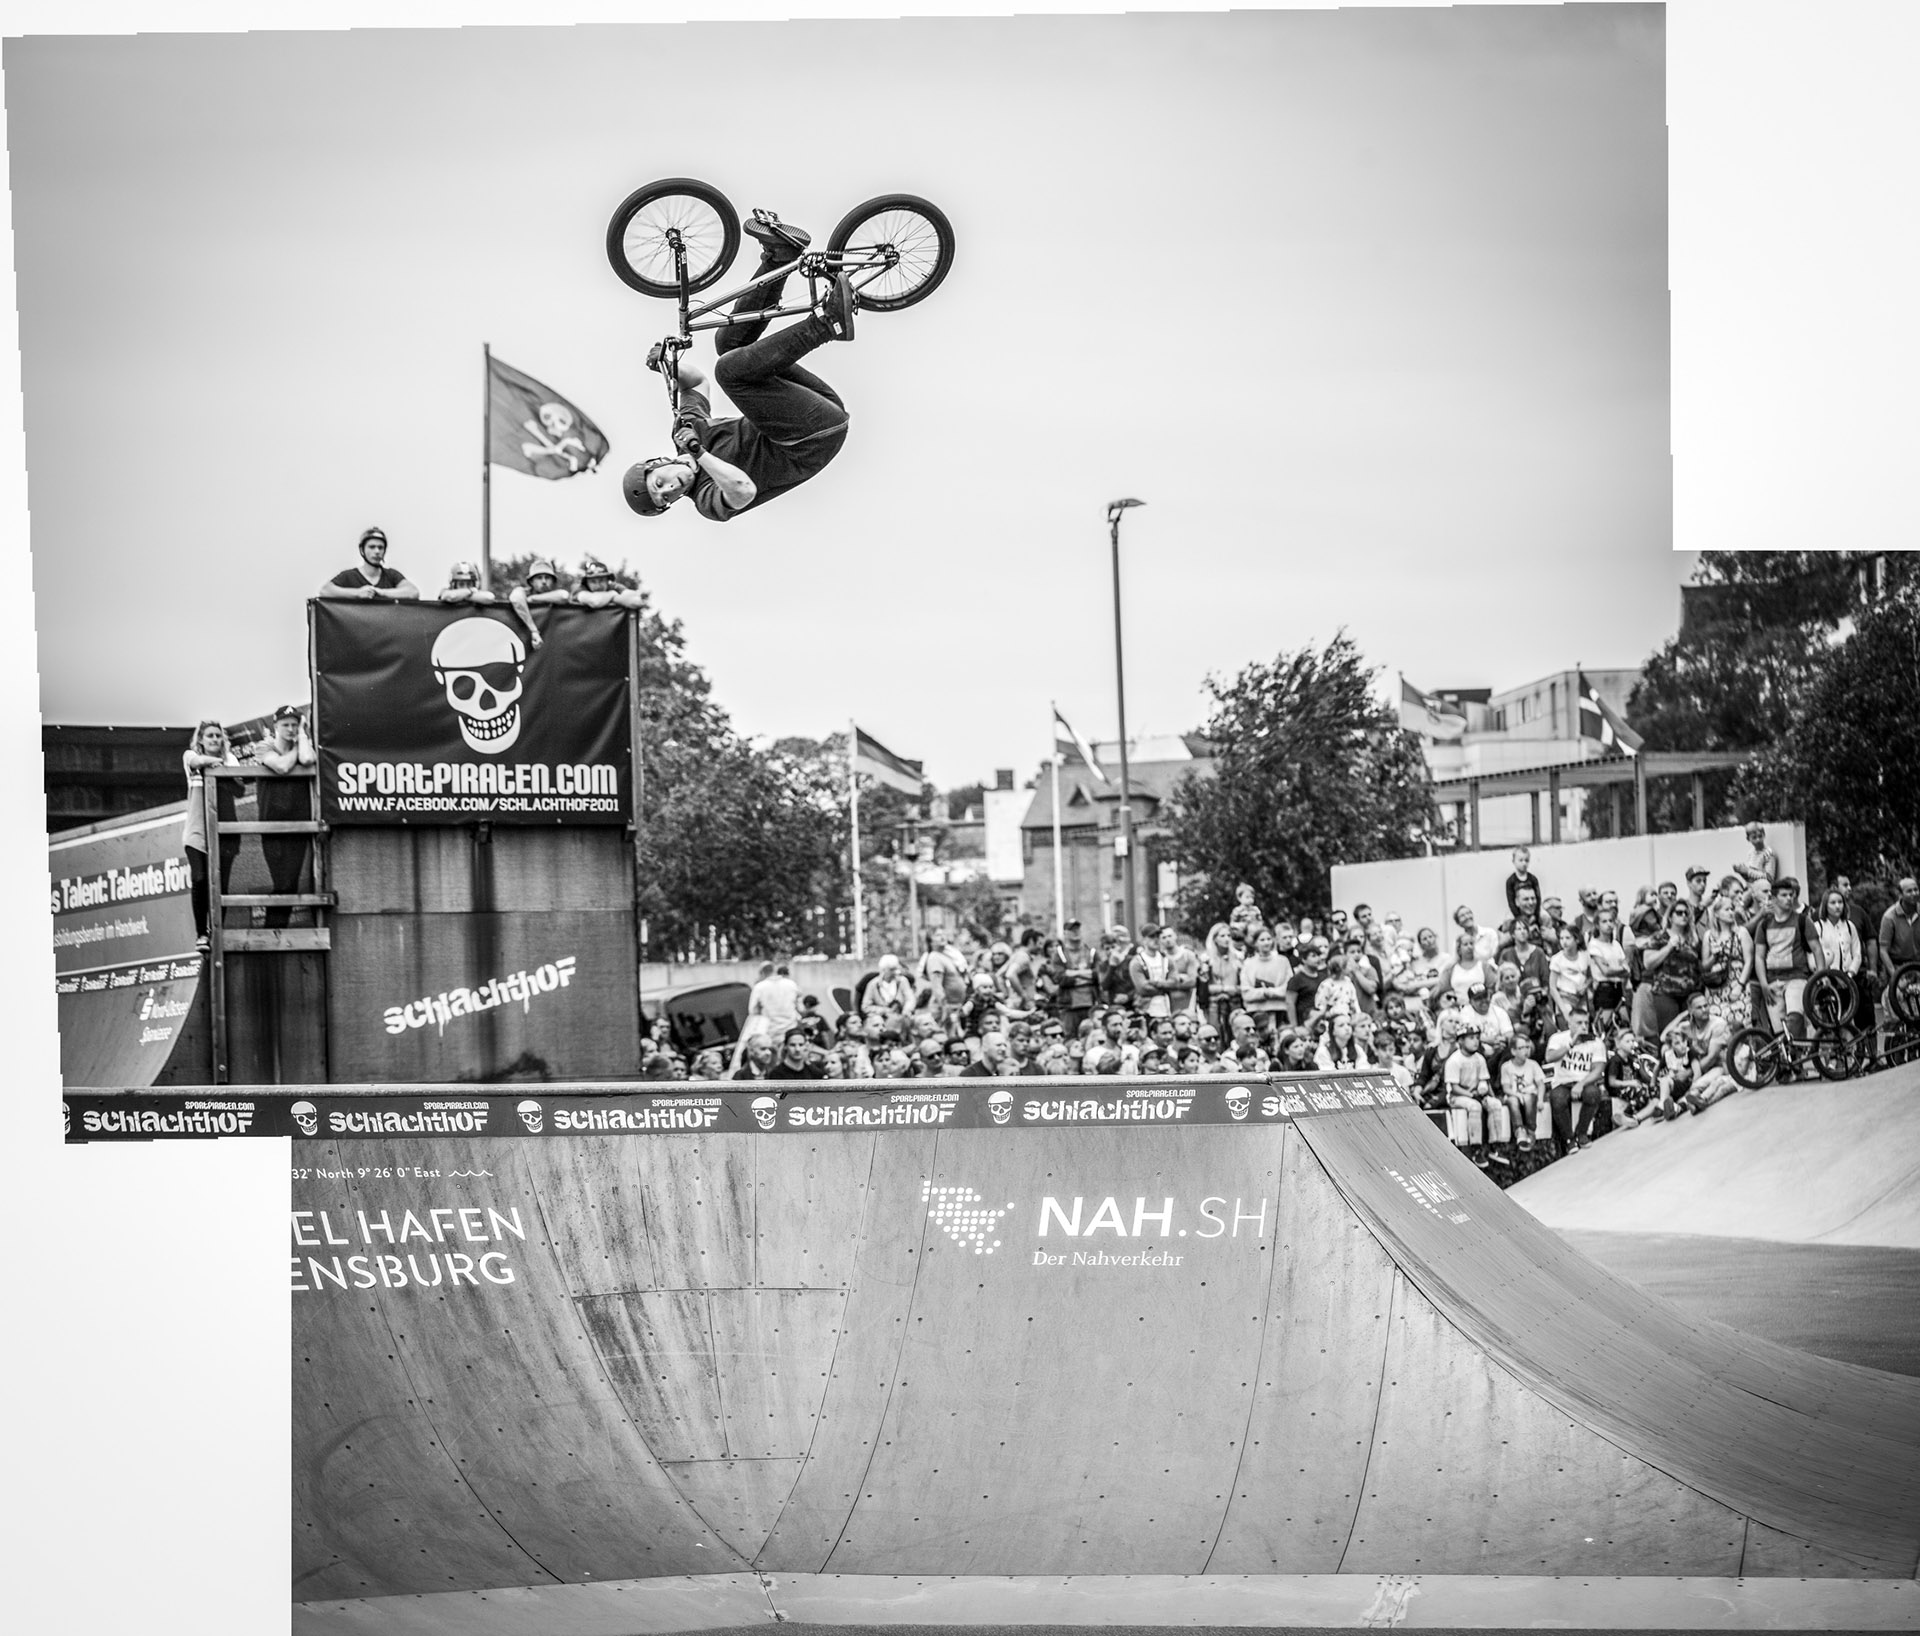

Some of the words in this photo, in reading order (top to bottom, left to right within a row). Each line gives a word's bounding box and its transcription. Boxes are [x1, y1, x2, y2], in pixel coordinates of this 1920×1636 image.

[337, 797, 620, 812] WWW.FACEBOOK.COM/SCHLACHTHOF2001
[60, 875, 109, 909] Talent:
[107, 864, 164, 901] Talente
[316, 1168, 354, 1179] North
[357, 1167, 371, 1178] 9°
[414, 1166, 441, 1178] East
[357, 1206, 526, 1244] HAFEN
[1031, 1251, 1067, 1266] Der
[1071, 1251, 1184, 1267] Nahverkehr
